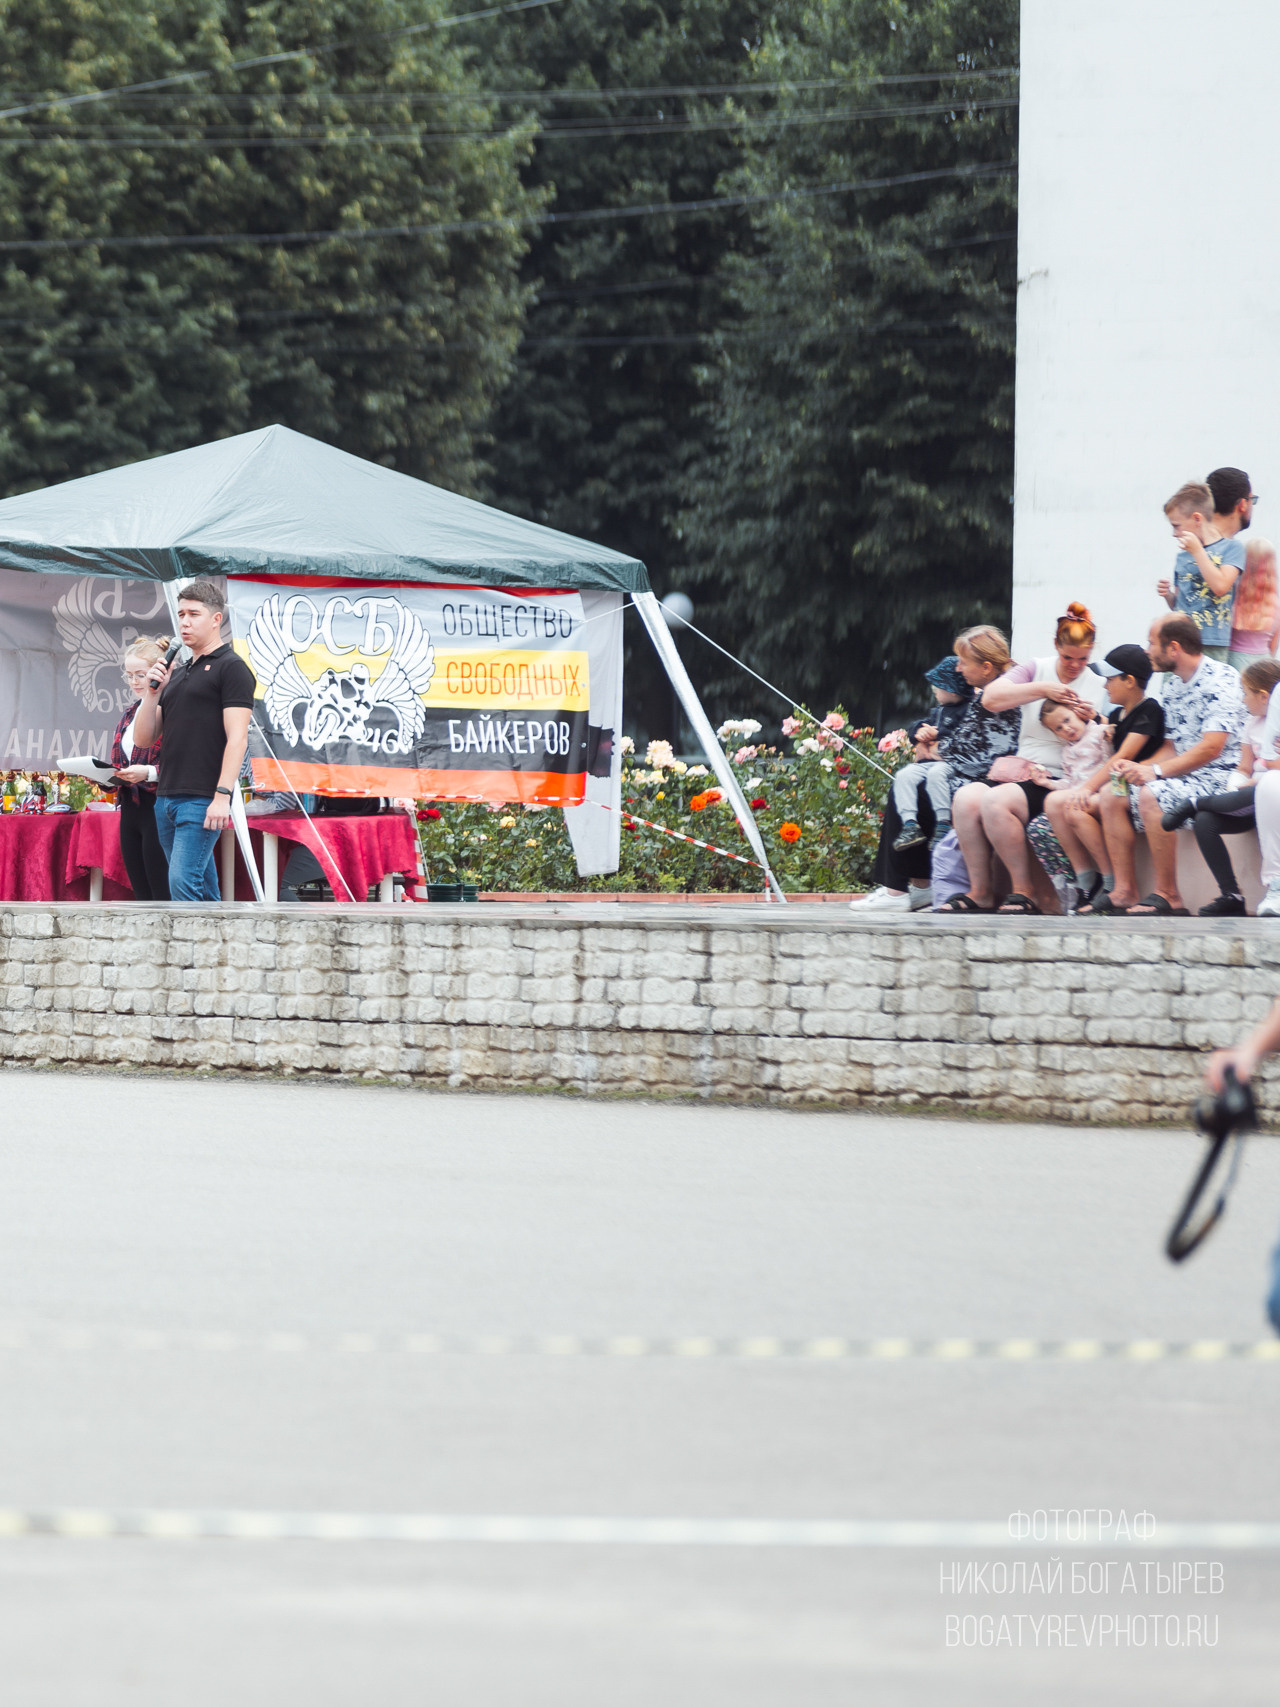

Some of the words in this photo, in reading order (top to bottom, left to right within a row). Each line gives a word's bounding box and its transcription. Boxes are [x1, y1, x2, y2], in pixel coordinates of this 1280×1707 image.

[283, 594, 398, 655] ОСБ
[442, 603, 573, 642] ОБЩЕСТВО
[446, 661, 581, 700] СВОБОДНЫХ
[448, 714, 570, 755] БАЙКЕРОВ
